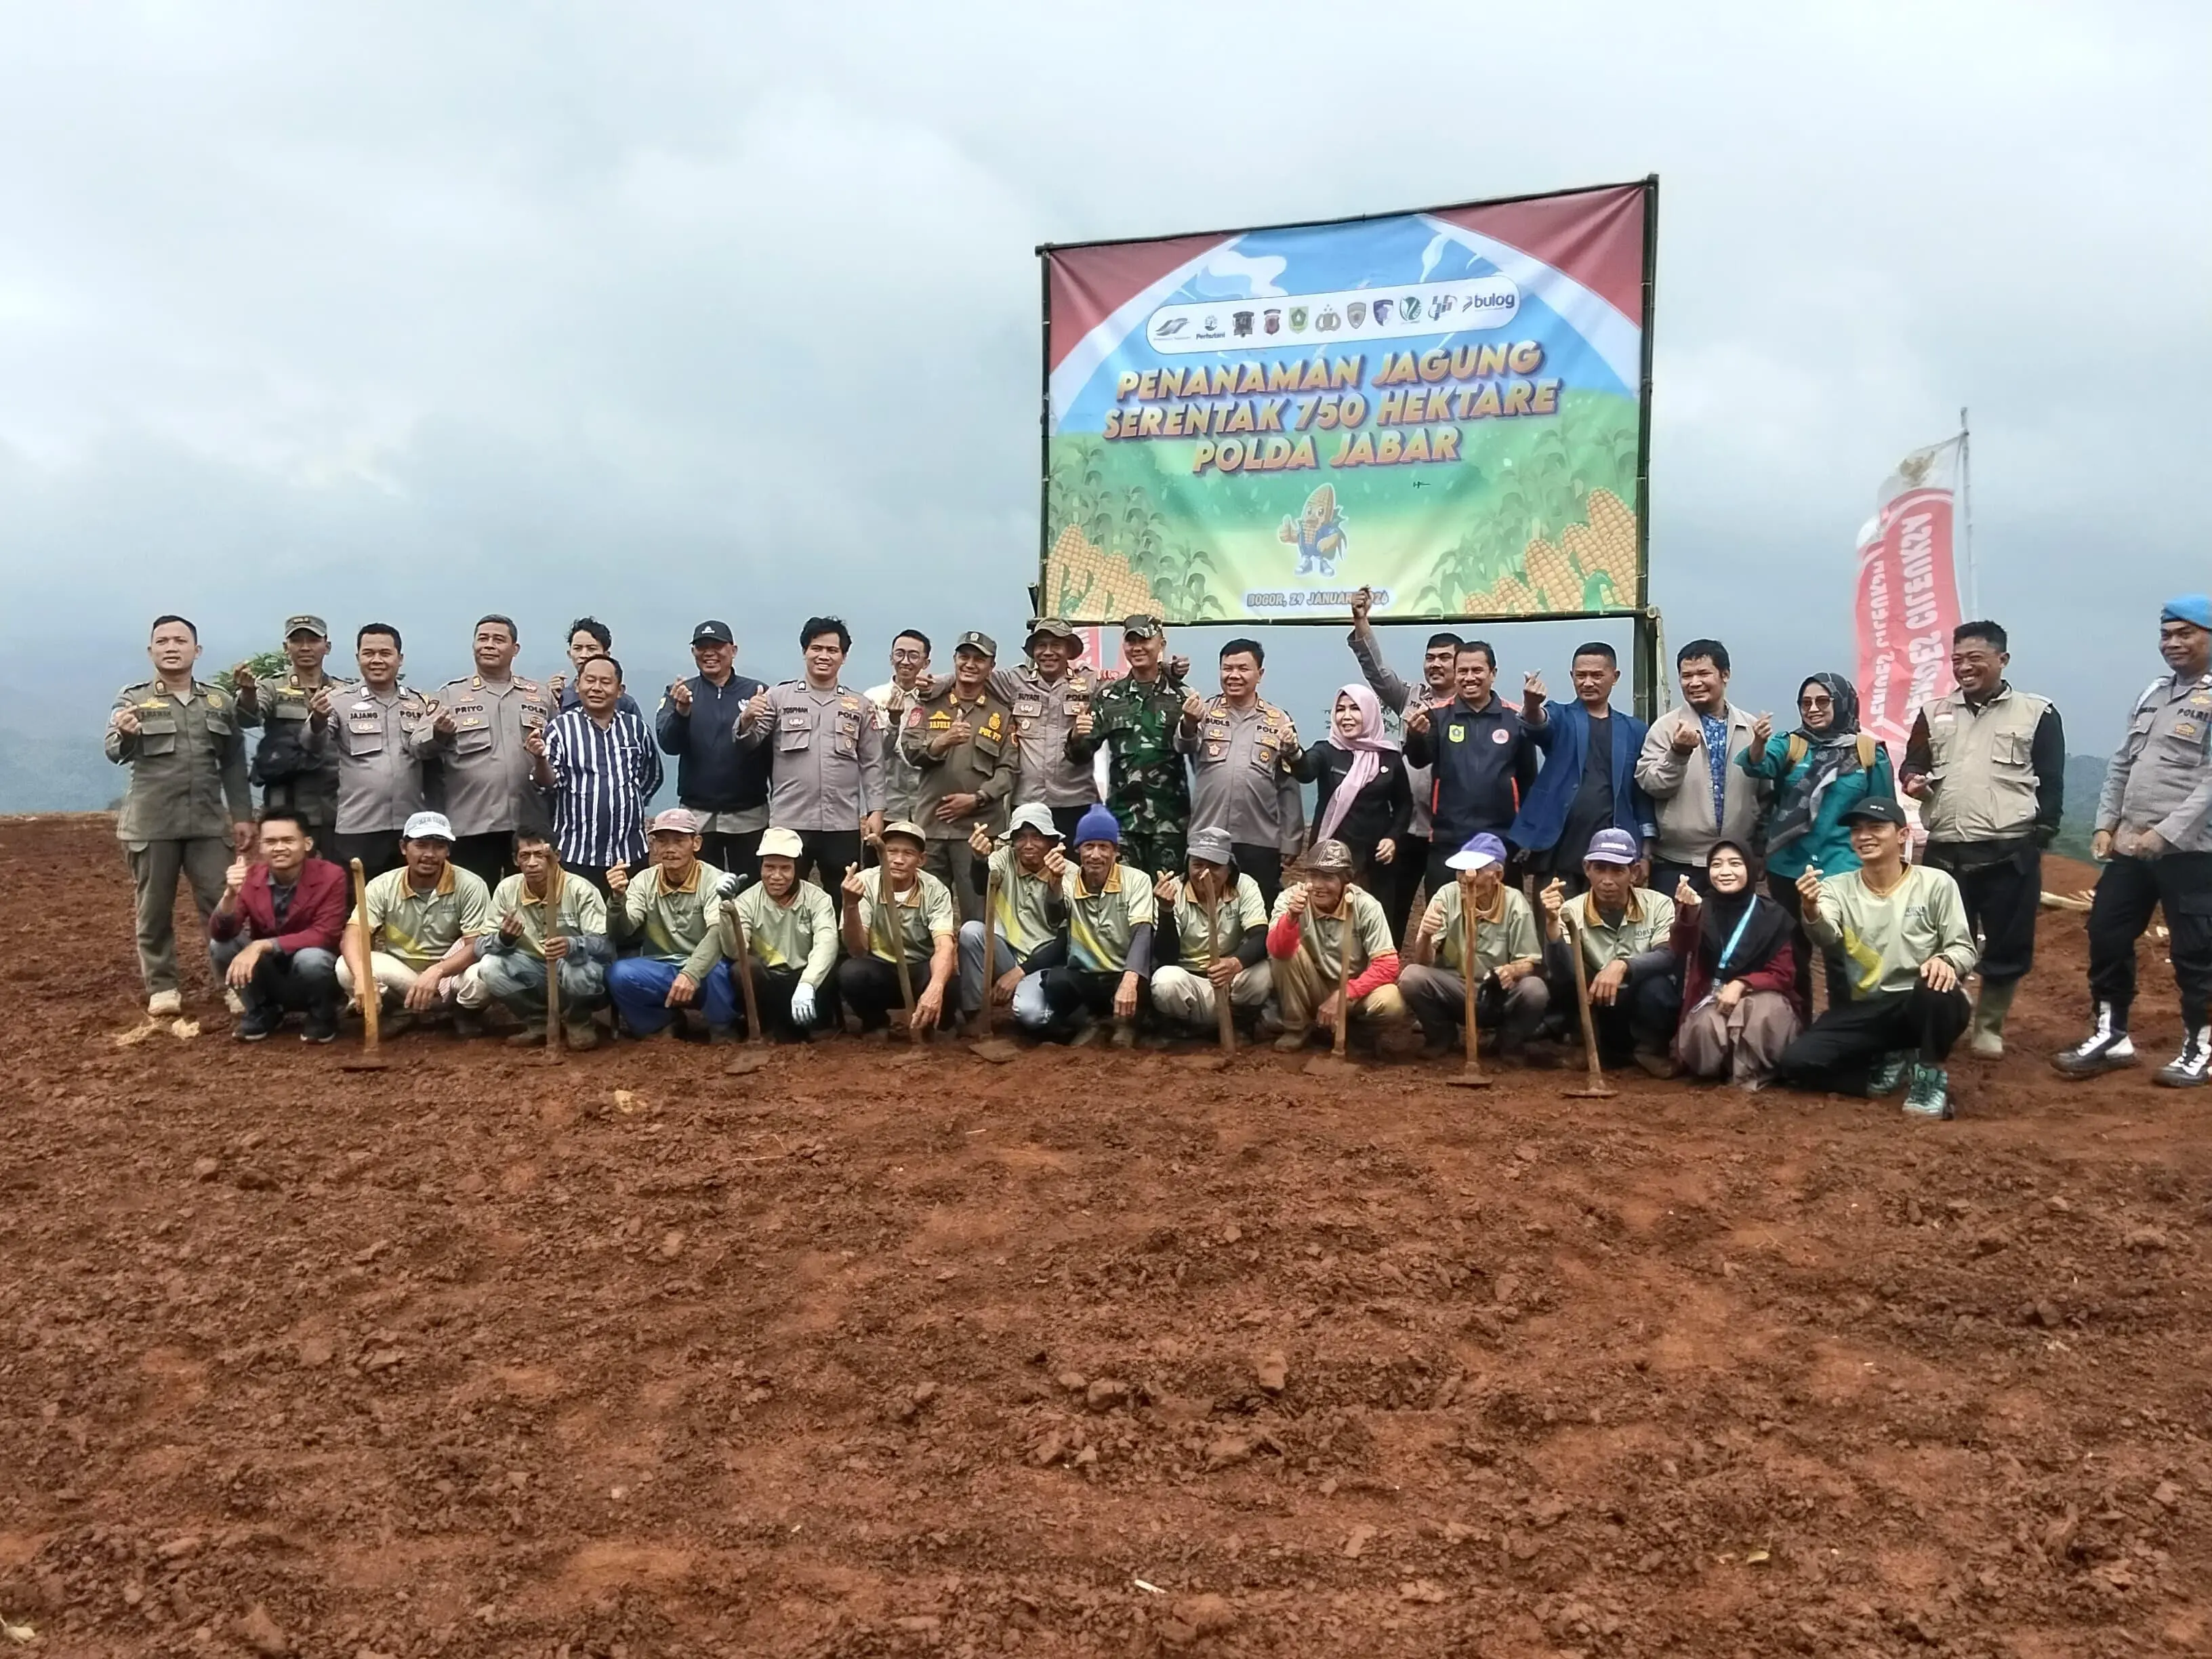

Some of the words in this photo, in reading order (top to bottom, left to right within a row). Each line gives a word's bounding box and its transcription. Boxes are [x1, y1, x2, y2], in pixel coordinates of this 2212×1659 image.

[1474, 293, 1515, 310] bulog
[1195, 331, 1225, 340] Perhutani
[1117, 354, 1364, 402] PENANAMAN
[1371, 340, 1543, 388] JAGUNG
[1103, 398, 1289, 439] SERENTAK
[1294, 392, 1367, 432] 750
[1377, 377, 1561, 426] HEKTARE
[1192, 434, 1319, 474] POLDA
[1329, 426, 1461, 467] JABAR
[1247, 594, 1287, 607] BOGOR,
[1289, 592, 1305, 606] 29
[1307, 591, 1353, 605] JANUAR
[350, 712, 378, 720] JAJANG
[455, 705, 484, 714] PRIYO
[521, 704, 547, 715] POLRI
[2177, 709, 2209, 722] POLRI
[838, 711, 860, 722] POLRI
